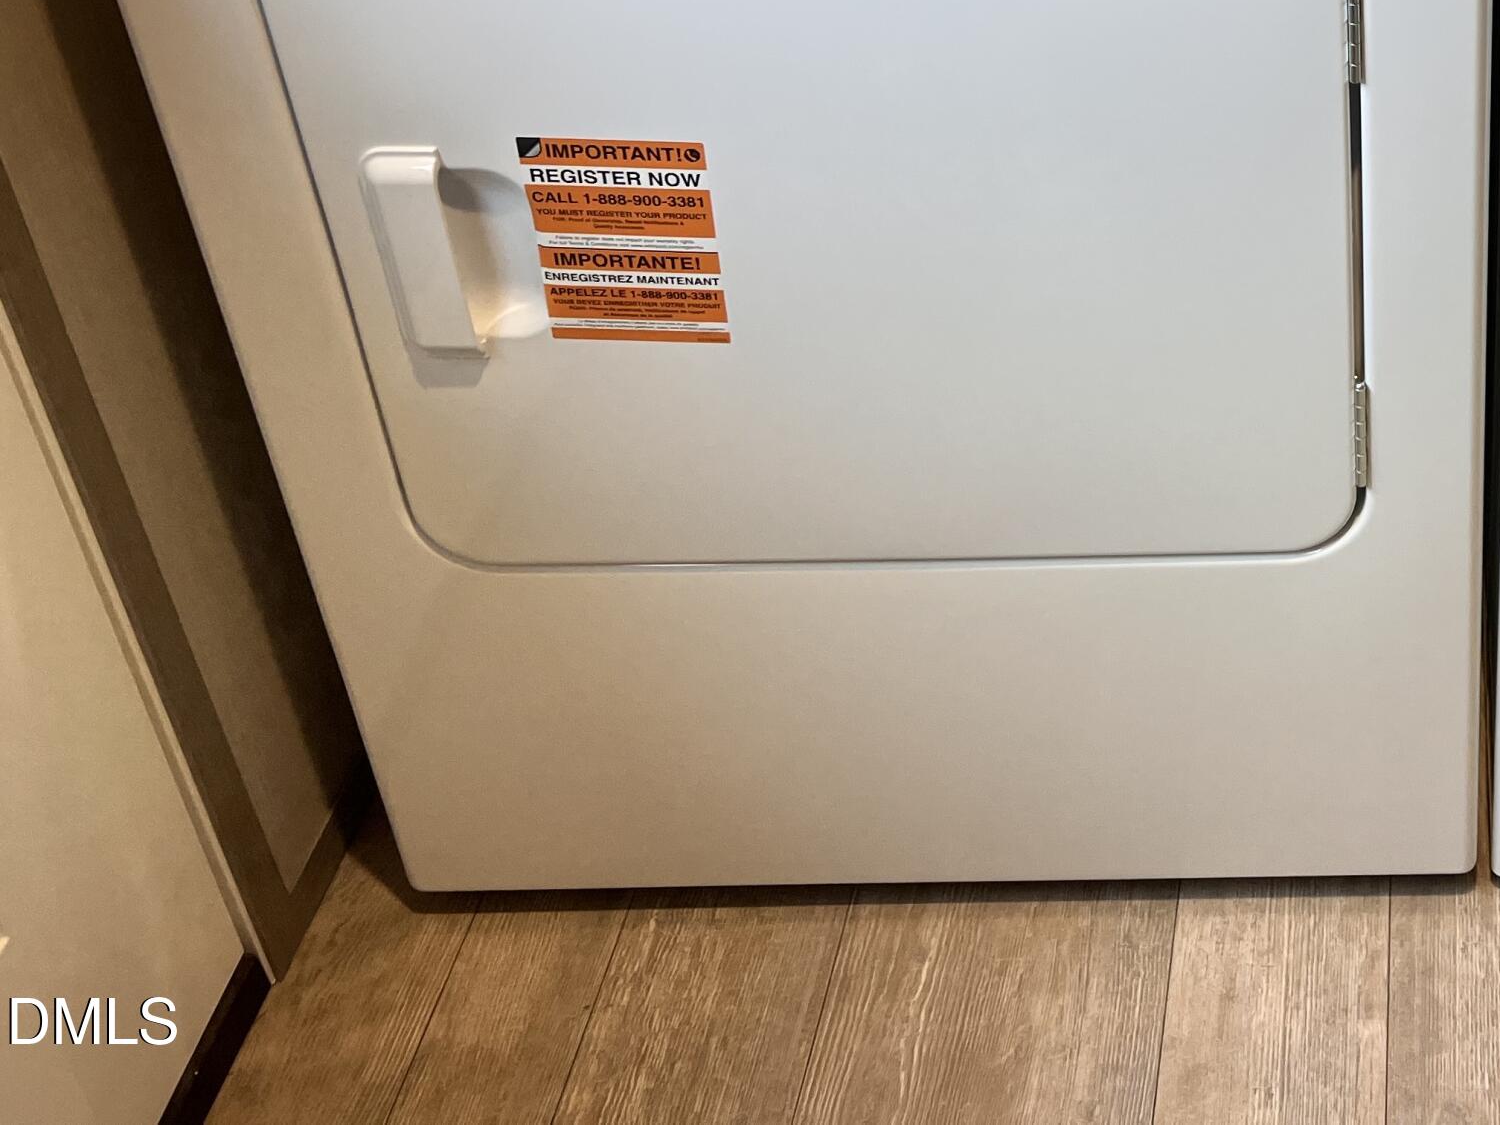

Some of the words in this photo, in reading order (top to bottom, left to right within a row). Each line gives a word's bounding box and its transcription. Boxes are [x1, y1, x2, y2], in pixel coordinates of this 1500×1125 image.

[545, 144, 681, 162] IMPORTANT!
[530, 168, 641, 185] REGISTER
[649, 172, 700, 187] NOW
[532, 191, 578, 204] CALL
[584, 194, 704, 208] 1-888-900-3381
[587, 210, 632, 218] REGISTER
[663, 212, 707, 220] PRODUCT
[554, 253, 700, 270] IMPORTANTE!
[545, 272, 633, 283] ENREGISTREZ
[637, 276, 719, 286] MAINTENANT
[550, 287, 607, 297] APPELEZ
[611, 289, 626, 298] LE
[631, 291, 718, 300] 1-888-900-3381
